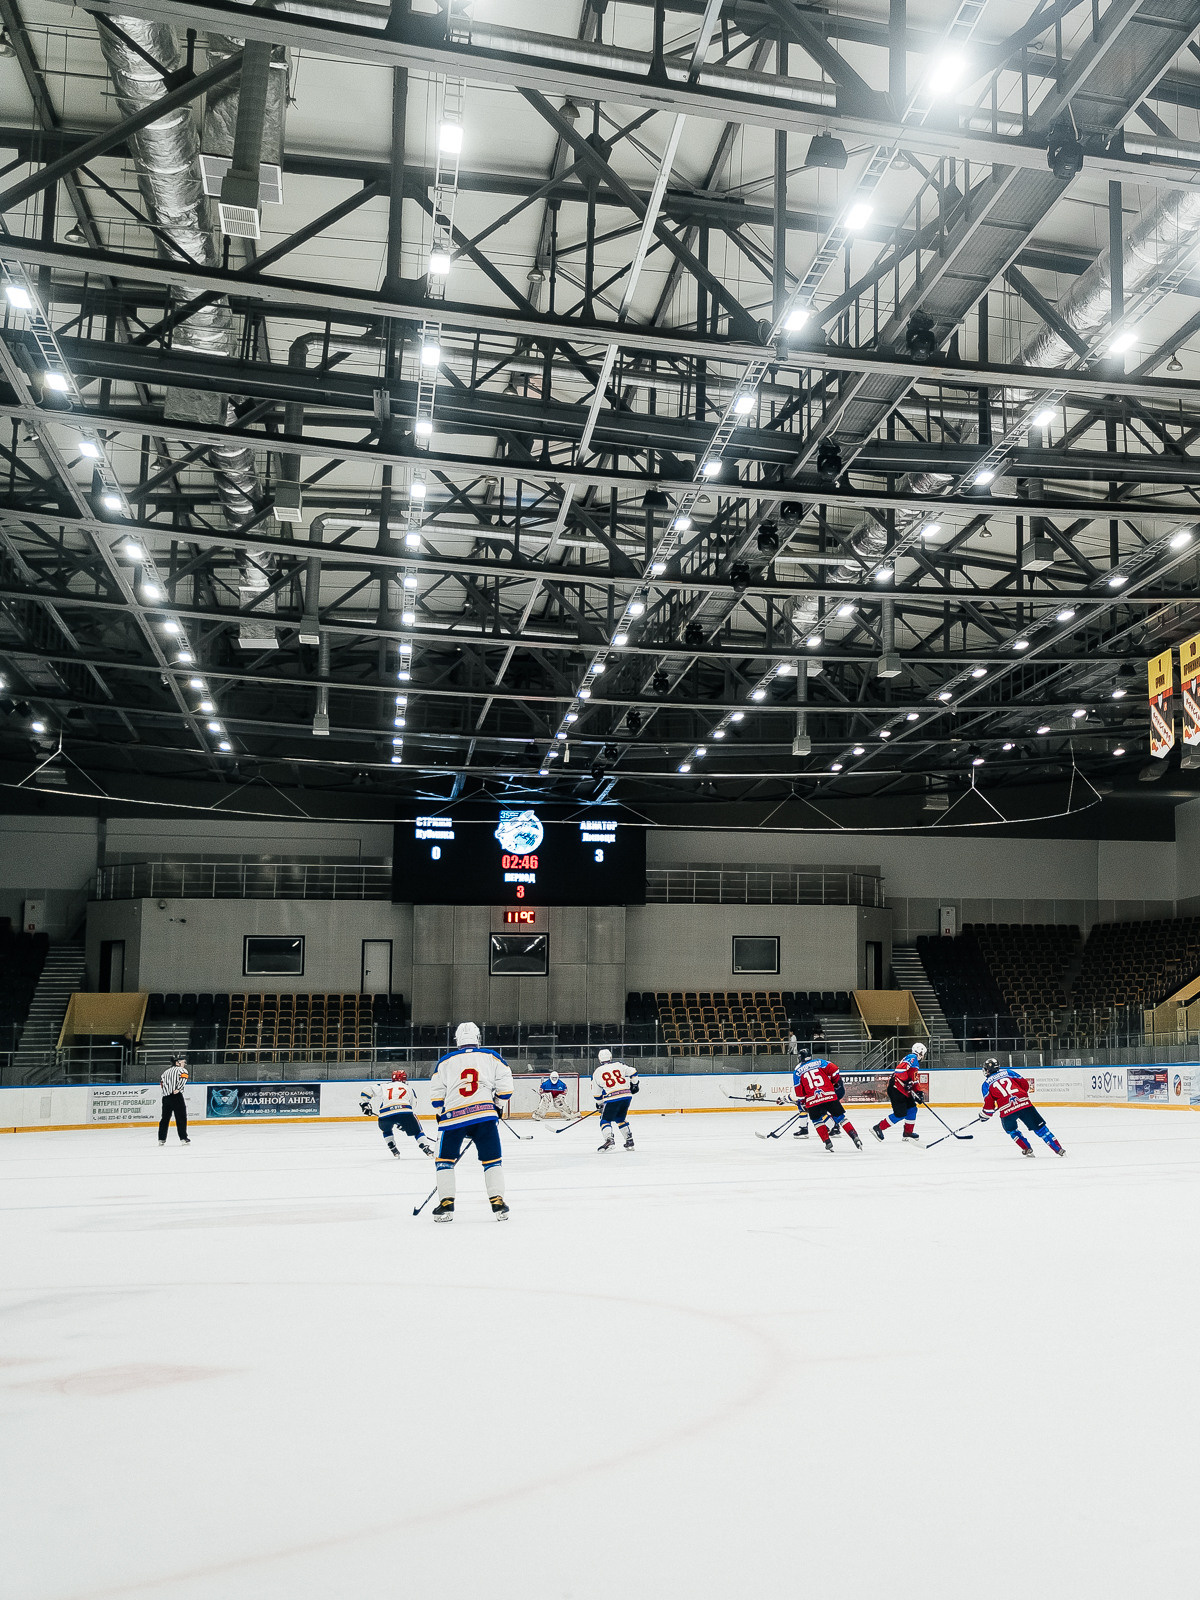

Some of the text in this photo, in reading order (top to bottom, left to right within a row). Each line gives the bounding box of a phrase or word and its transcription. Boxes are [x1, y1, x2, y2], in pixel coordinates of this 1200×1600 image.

[1158, 659, 1162, 672] 1
[579, 821, 618, 831] АВИАТОР
[431, 846, 441, 860] 0
[594, 848, 604, 862] 3
[501, 854, 539, 869] 02:46
[504, 872, 536, 883] ПЕРИОД
[516, 885, 525, 898] 3
[459, 1068, 479, 1097] 3
[602, 1069, 627, 1088] 88
[803, 1069, 825, 1089] 15
[992, 1077, 1019, 1097] 12
[92, 1099, 157, 1107] ИНТЕРНЕТ-ПРОВАЙДЕР
[241, 1096, 316, 1105] ЛЕДЯНОЙ АНГЕЛ
